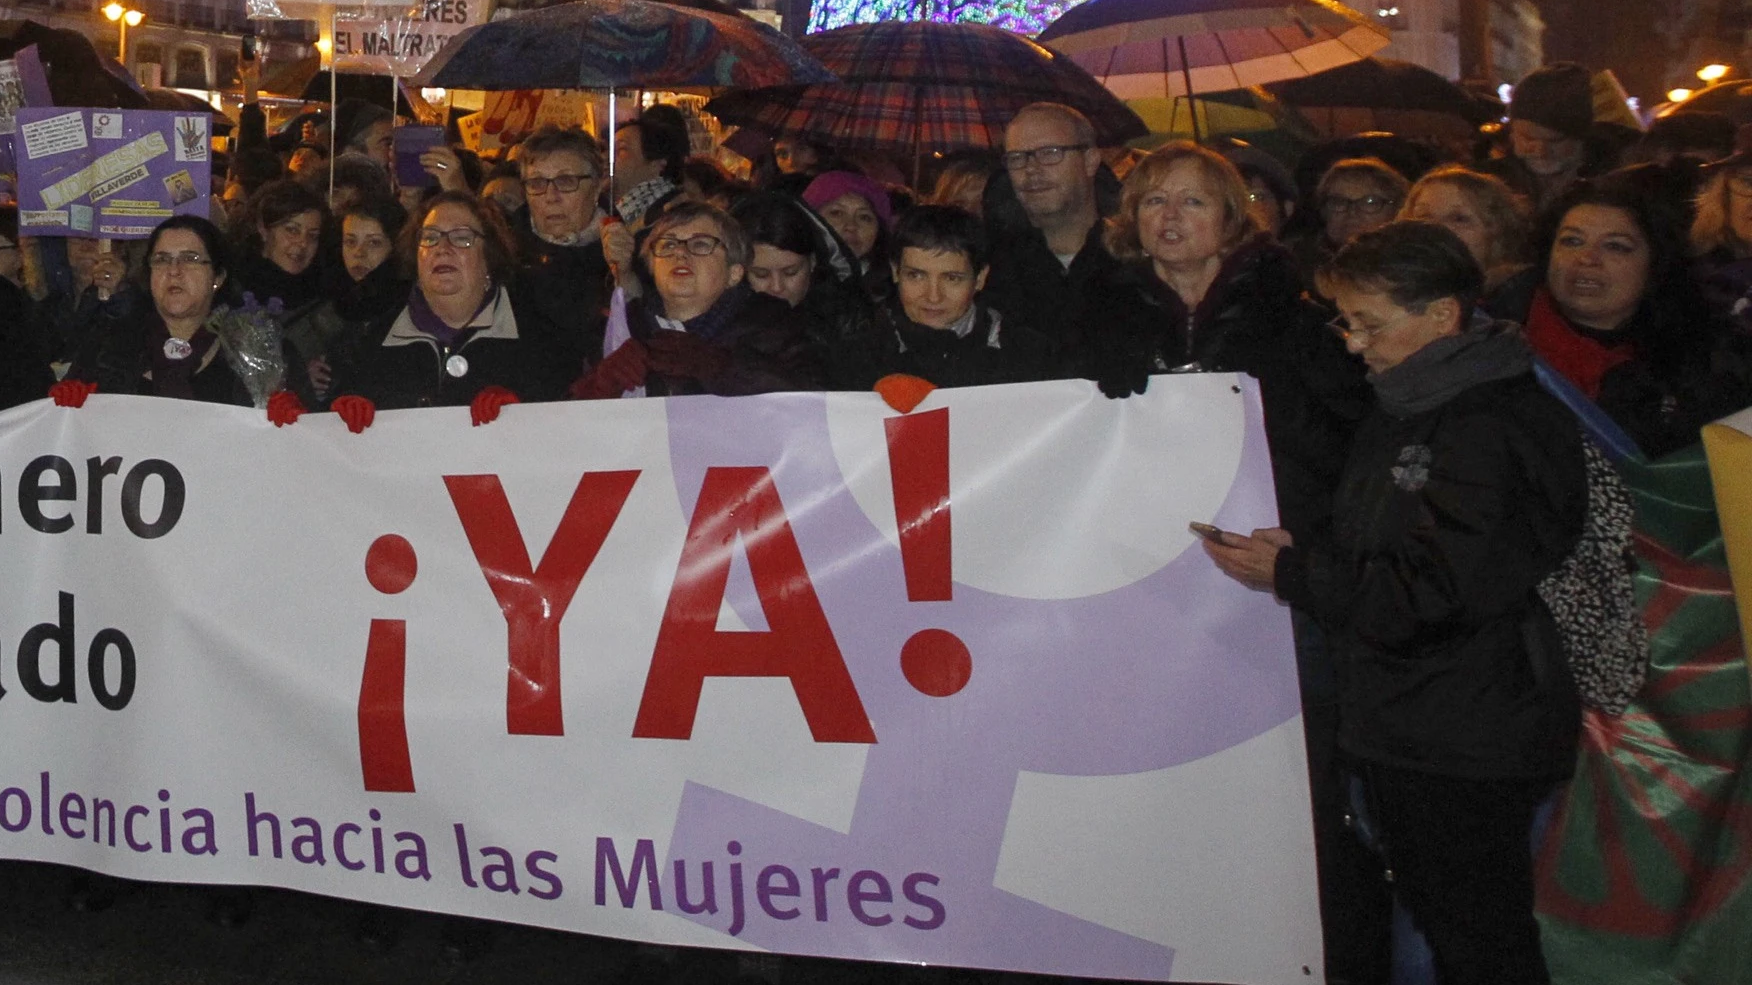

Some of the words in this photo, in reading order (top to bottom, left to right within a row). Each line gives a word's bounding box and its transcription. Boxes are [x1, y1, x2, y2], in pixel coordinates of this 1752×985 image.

[357, 407, 973, 793] ¡YA!
[244, 792, 432, 882] hacia
[453, 823, 565, 900] las
[594, 836, 948, 936] Mujeres
